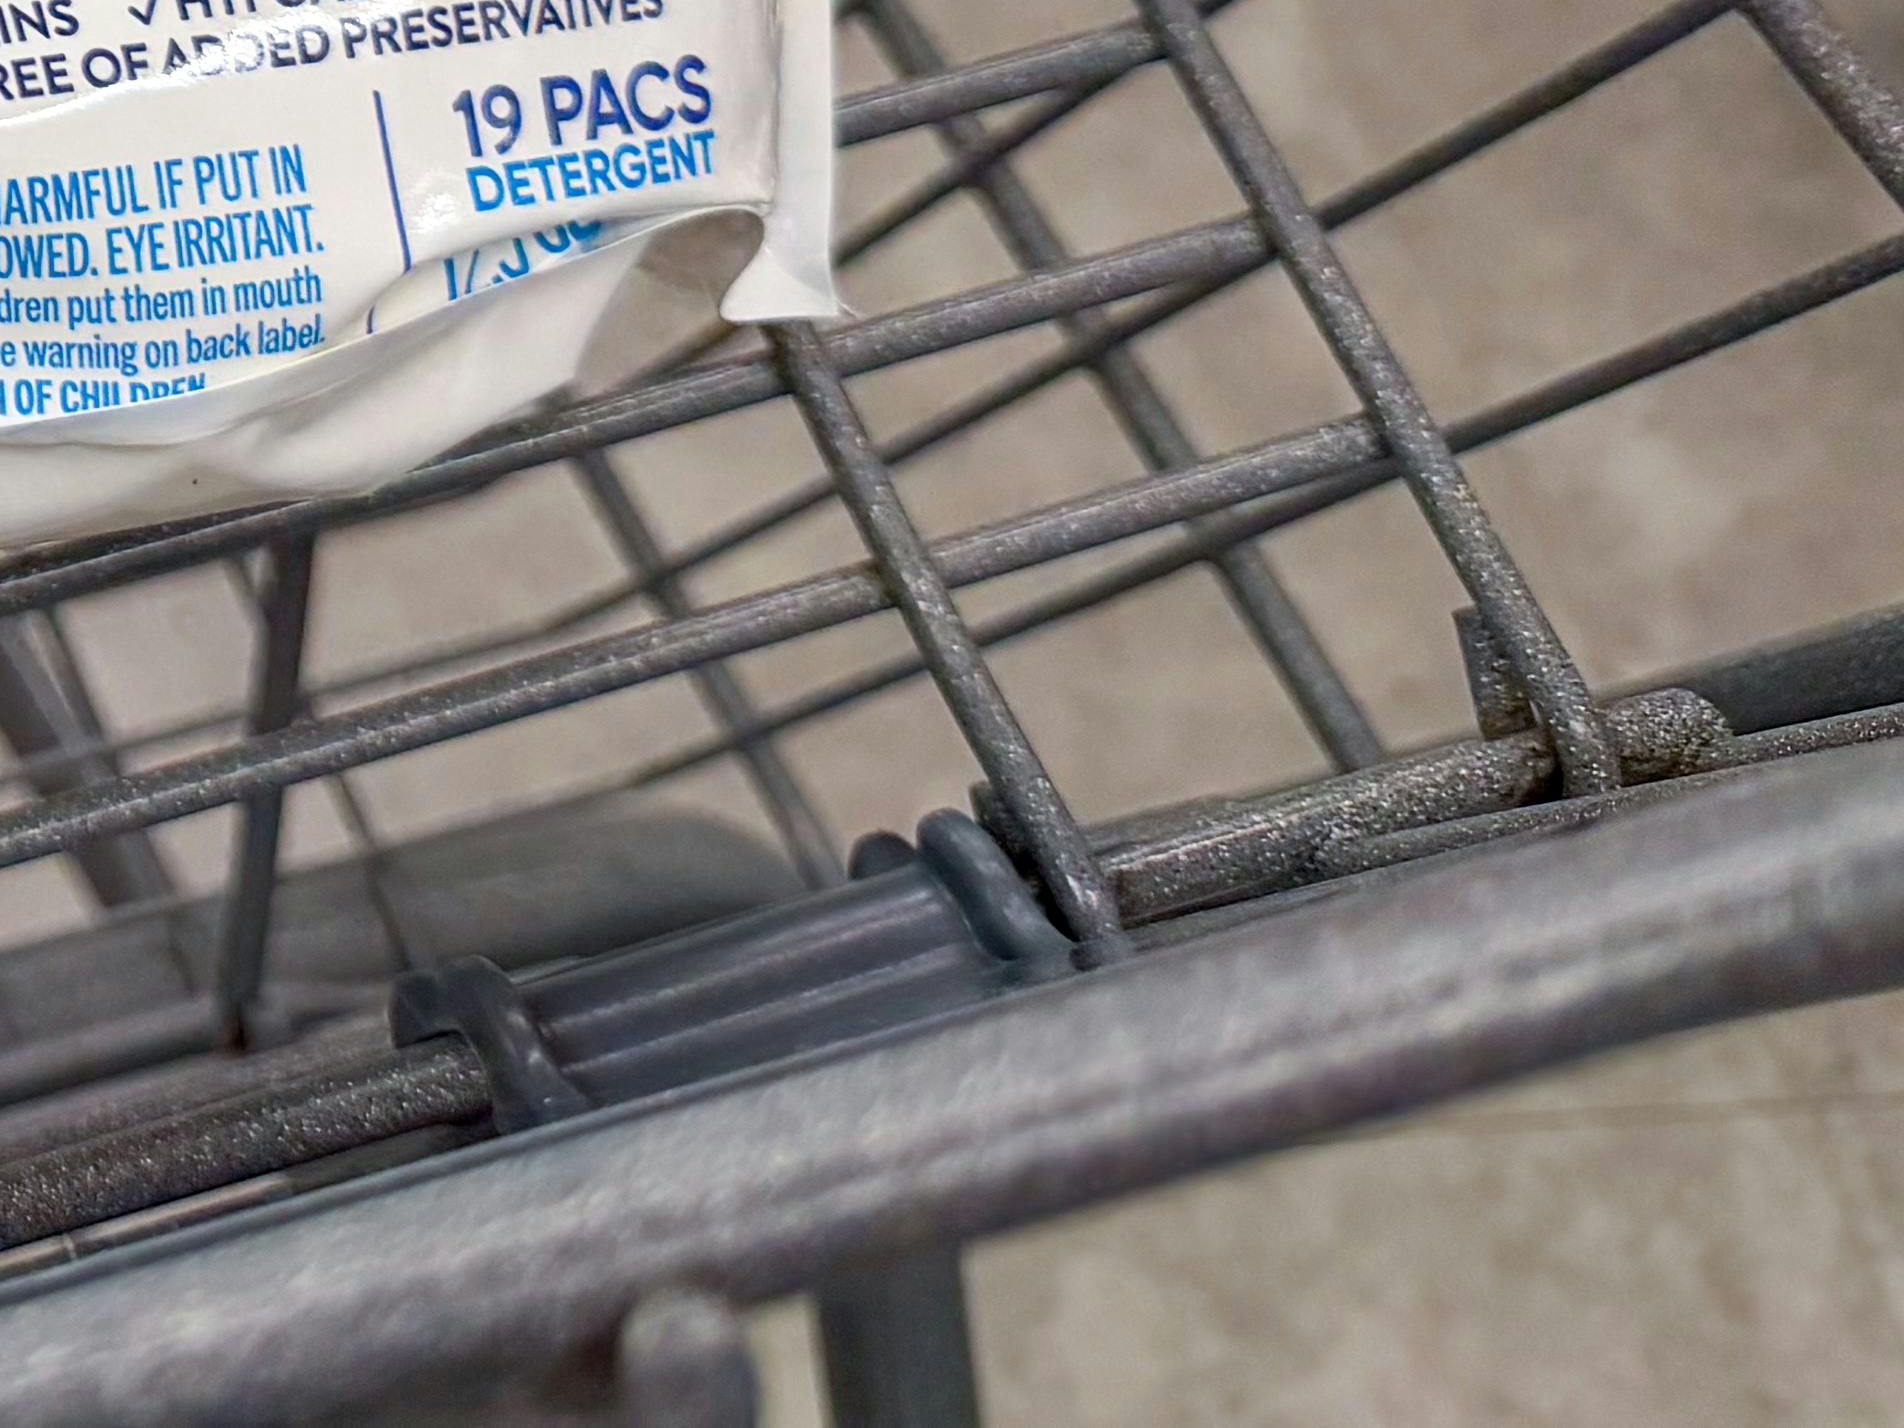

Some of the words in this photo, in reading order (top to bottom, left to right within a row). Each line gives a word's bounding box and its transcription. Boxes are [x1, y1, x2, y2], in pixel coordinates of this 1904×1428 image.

[82, 41, 149, 90] OF
[161, 23, 331, 76] ADDED
[451, 84, 522, 161] 19
[539, 53, 714, 145] PACS
[155, 158, 184, 211] IF
[192, 150, 260, 206] PUT
[267, 143, 308, 195] IN
[466, 129, 716, 213] DETERGENT
[106, 227, 167, 278] EYE
[174, 203, 326, 266] IRRITANT.
[66, 287, 119, 330] put
[121, 280, 196, 320] them
[199, 274, 228, 314] in
[232, 265, 323, 311] mouth
[20, 331, 138, 379] warning
[142, 335, 180, 368] on
[184, 321, 251, 365] back
[255, 314, 326, 353] label.
[13, 376, 53, 414] OF
